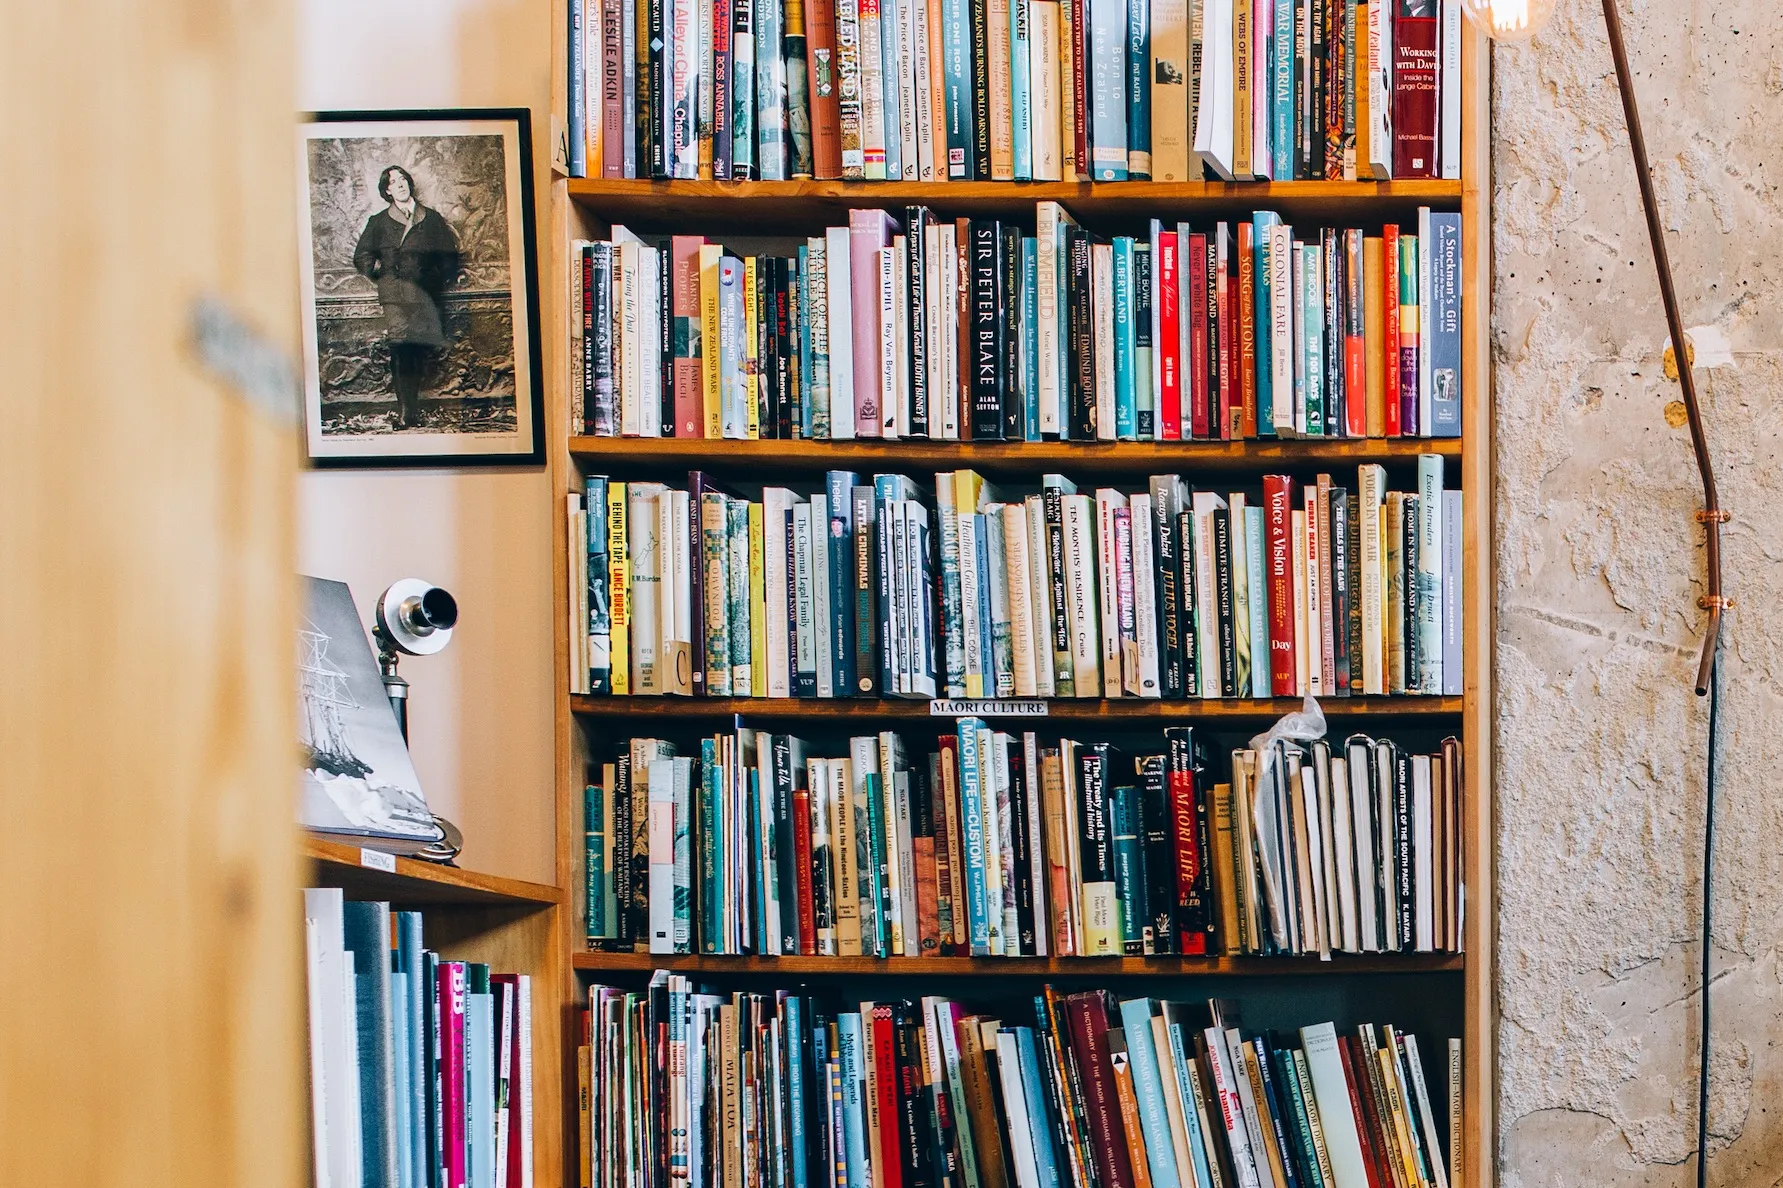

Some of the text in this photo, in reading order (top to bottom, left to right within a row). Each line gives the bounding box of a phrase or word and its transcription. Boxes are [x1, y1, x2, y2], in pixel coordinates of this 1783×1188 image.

[605, 10, 617, 56] LESLIE
[917, 6, 927, 80] The Price of Bacon
[1238, 12, 1246, 91] WEBS OF EMPIRE
[1277, 1, 1290, 106] WAR MEMORIAL
[1296, 7, 1304, 58] ON THE MOVE
[605, 59, 617, 100] ADKIN
[715, 56, 724, 133] ROSS ANNABELL
[919, 87, 930, 144] Jeanette Aplin
[883, 250, 892, 312] ZERO-ALPHA
[1117, 253, 1127, 323] ALBERTLAND
[1193, 246, 1202, 272] Never
[1208, 244, 1217, 319] MAKING A STAND
[1275, 234, 1286, 337] COLONIAL FARE
[1445, 225, 1457, 333] A Stockman's Gift
[708, 315, 716, 334] NEW
[978, 230, 995, 385] SIR PETER BLAKE
[1193, 310, 1204, 328] flag
[1194, 283, 1203, 308] white
[709, 335, 717, 371] ZEALAND
[778, 356, 786, 370] Joe
[884, 323, 894, 392] Ray Van Beynen
[1080, 334, 1092, 407] EDMUND BOHAN
[831, 480, 842, 512] helen
[612, 502, 623, 564] BEHIND THE TAPE
[1069, 505, 1083, 623] TEN MONTHS' RESIDENCE
[1272, 491, 1286, 576] Voice & Vision
[1308, 532, 1316, 560] DEAKER
[613, 568, 624, 626] LANCE BURDETT
[797, 517, 809, 628] The Chapman Legal Family
[933, 702, 1044, 713] MAORI CULTURE
[1176, 791, 1194, 882] MAORI LIFE
[1220, 1088, 1235, 1131] Tuamaka
